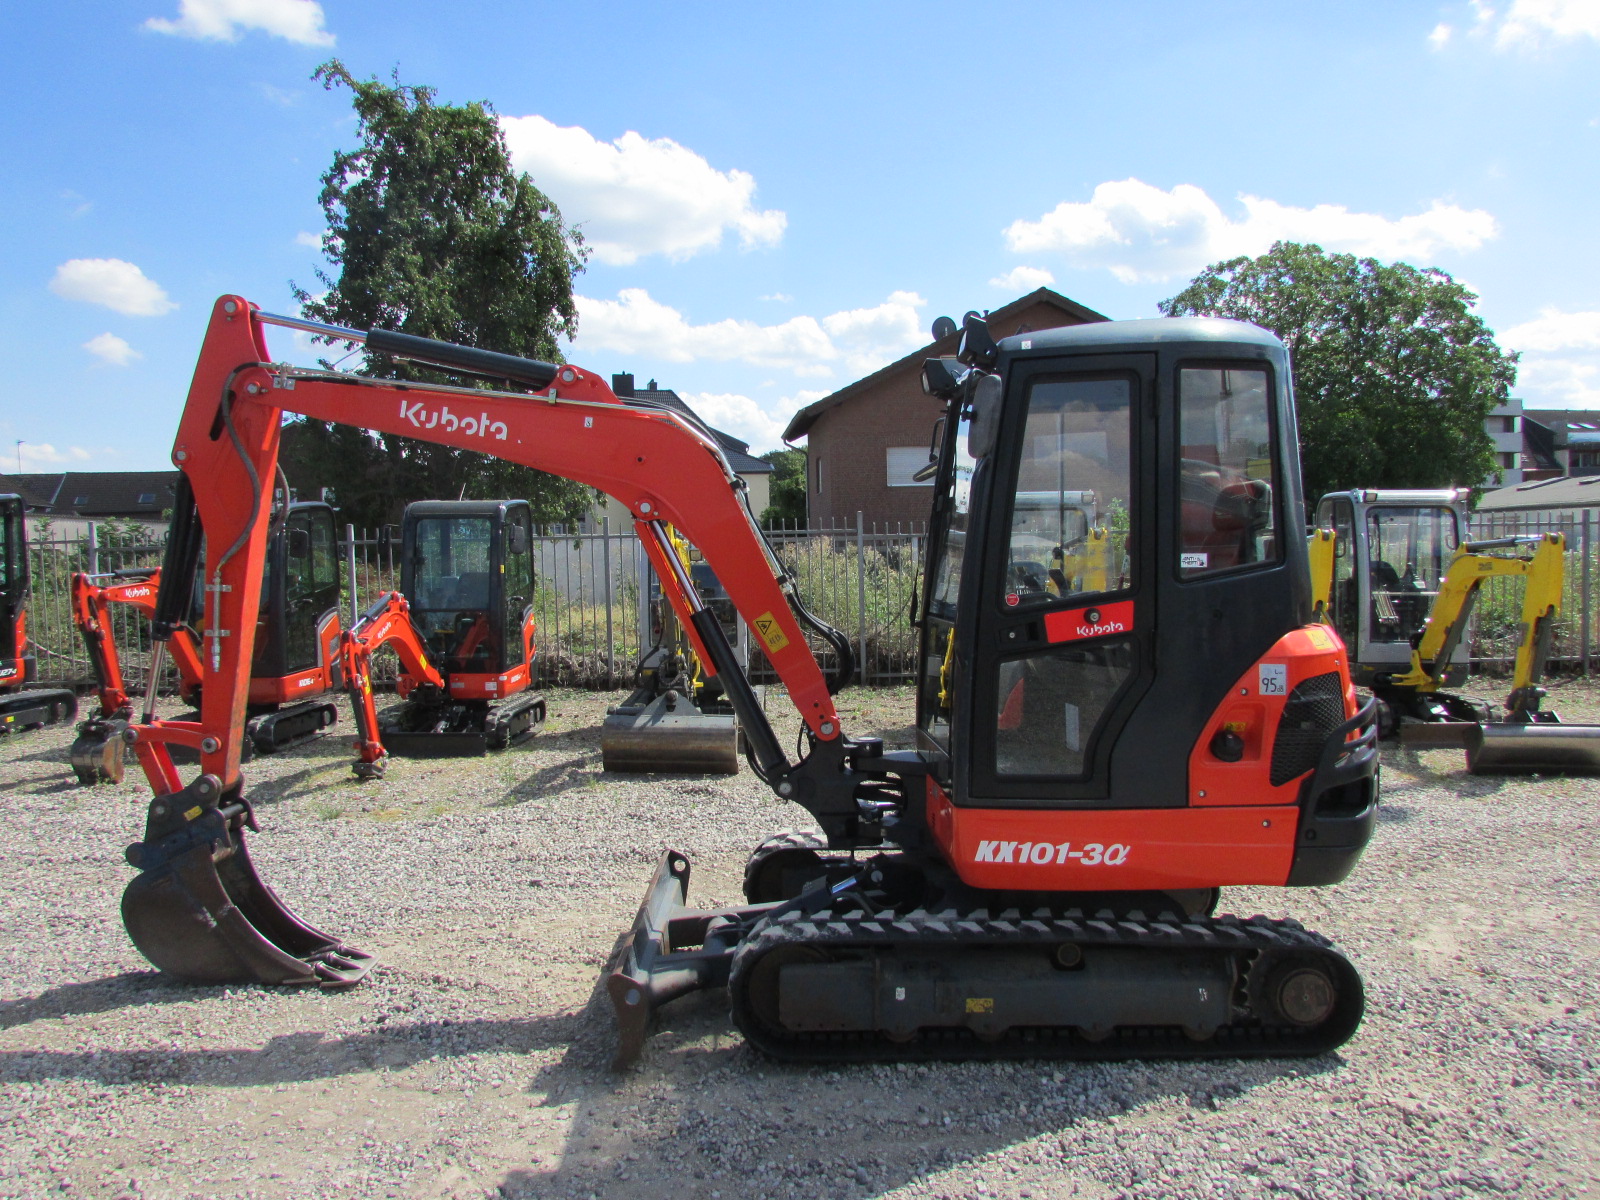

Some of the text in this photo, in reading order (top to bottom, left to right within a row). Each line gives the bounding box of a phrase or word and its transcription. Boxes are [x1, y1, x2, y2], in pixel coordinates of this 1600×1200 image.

[399, 400, 508, 440] Kubota
[125, 587, 150, 598] Kubota
[1076, 621, 1123, 636] Kubota
